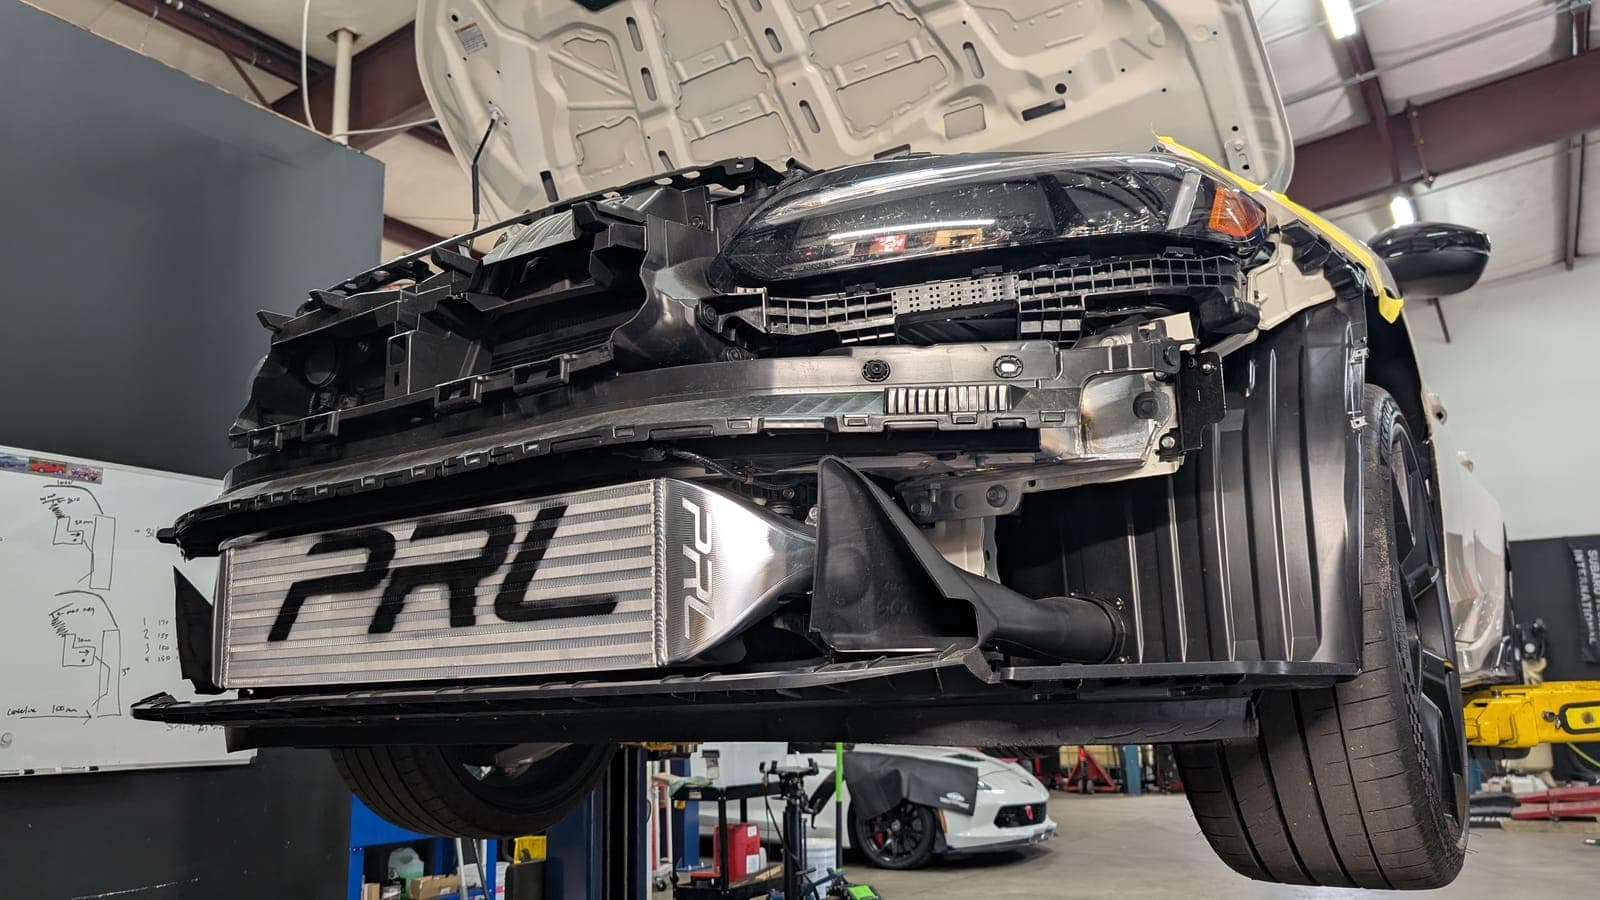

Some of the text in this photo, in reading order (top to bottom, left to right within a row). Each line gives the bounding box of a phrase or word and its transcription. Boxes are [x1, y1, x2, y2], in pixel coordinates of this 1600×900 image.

[268, 505, 618, 642] PRL
[682, 497, 716, 640] PRL
[1573, 549, 1597, 645] INTERNATIONAL
[1587, 549, 1600, 595] SUBARU
